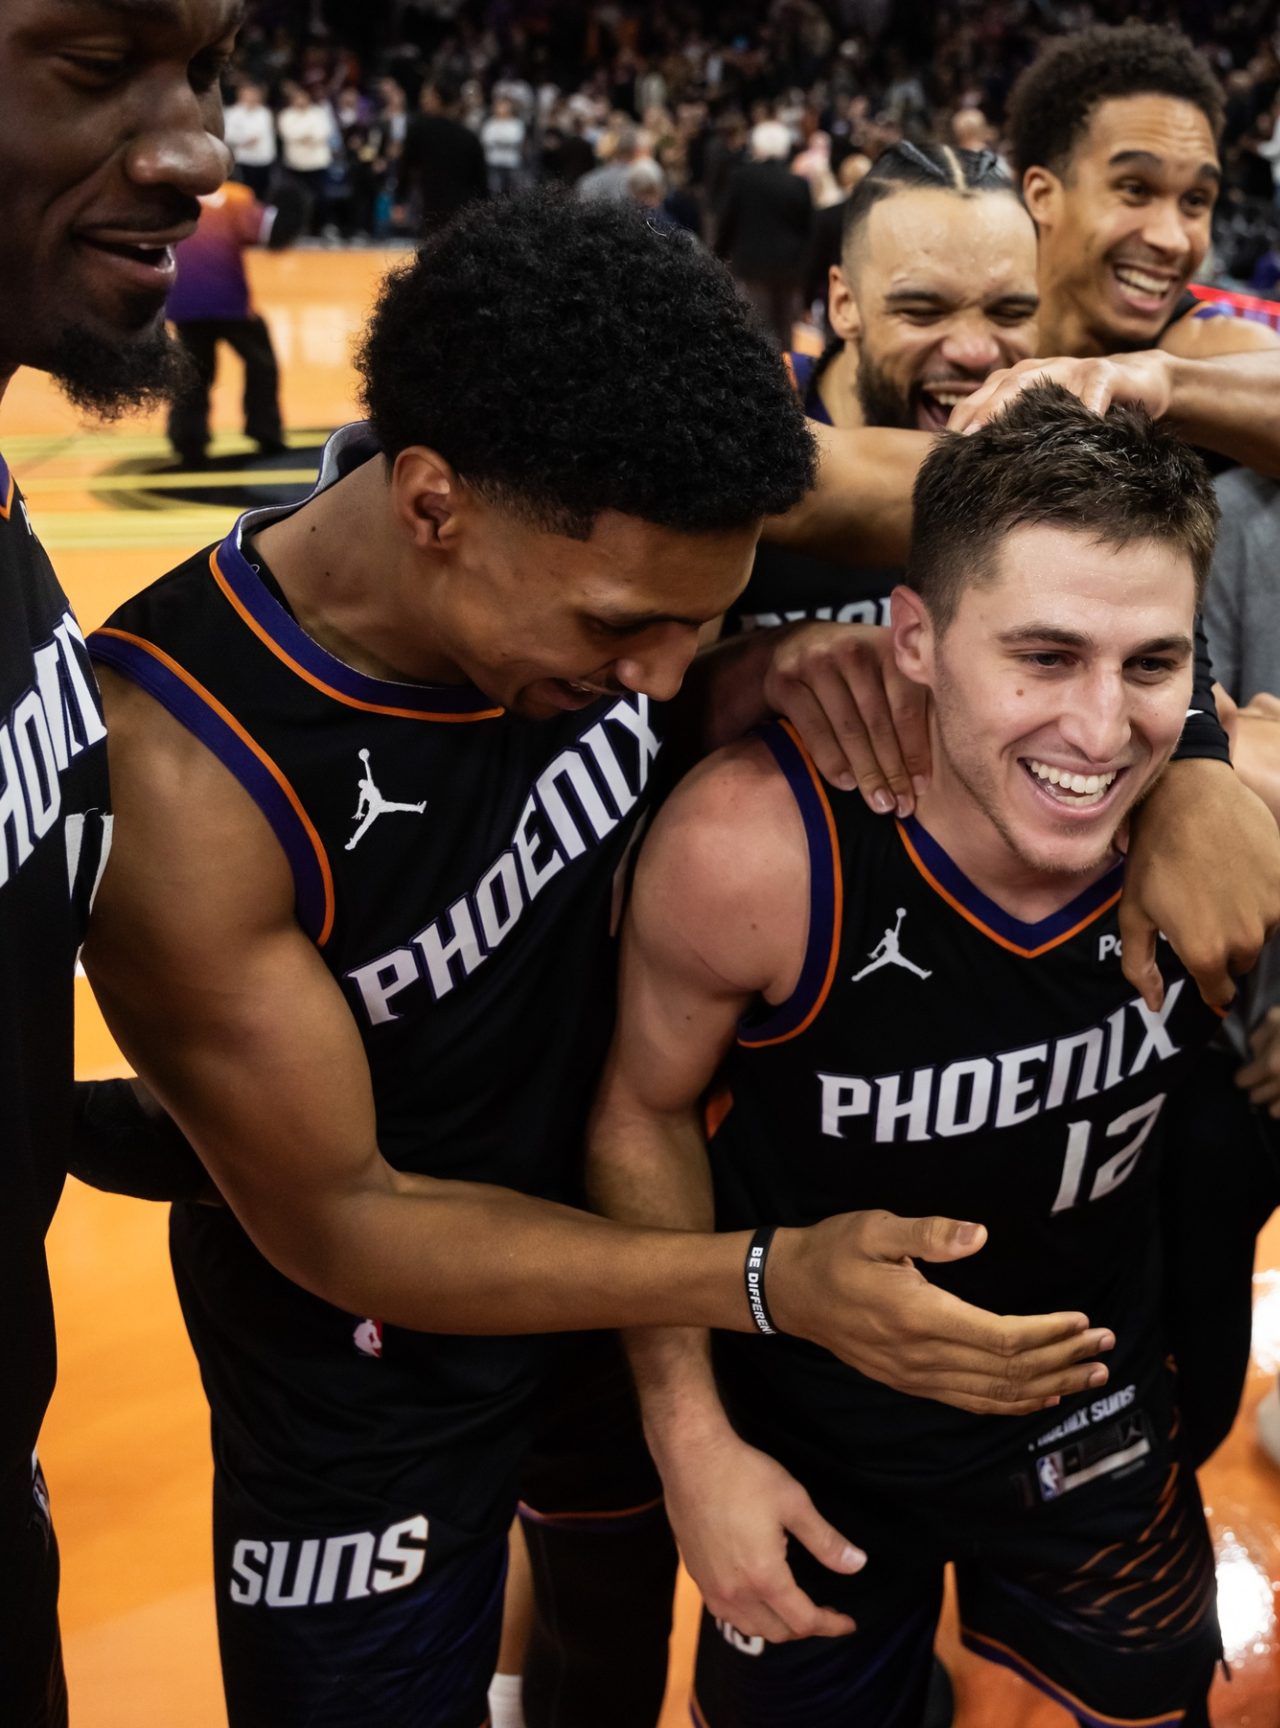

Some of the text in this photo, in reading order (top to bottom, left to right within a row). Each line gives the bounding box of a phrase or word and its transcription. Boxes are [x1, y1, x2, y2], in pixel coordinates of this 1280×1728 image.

[347, 692, 662, 1025] PHOENIX
[816, 979, 1184, 1143] PHOENIX
[1051, 1093, 1167, 1215] 12
[748, 1246, 764, 1268] BE
[230, 1514, 429, 1607] SUNS
